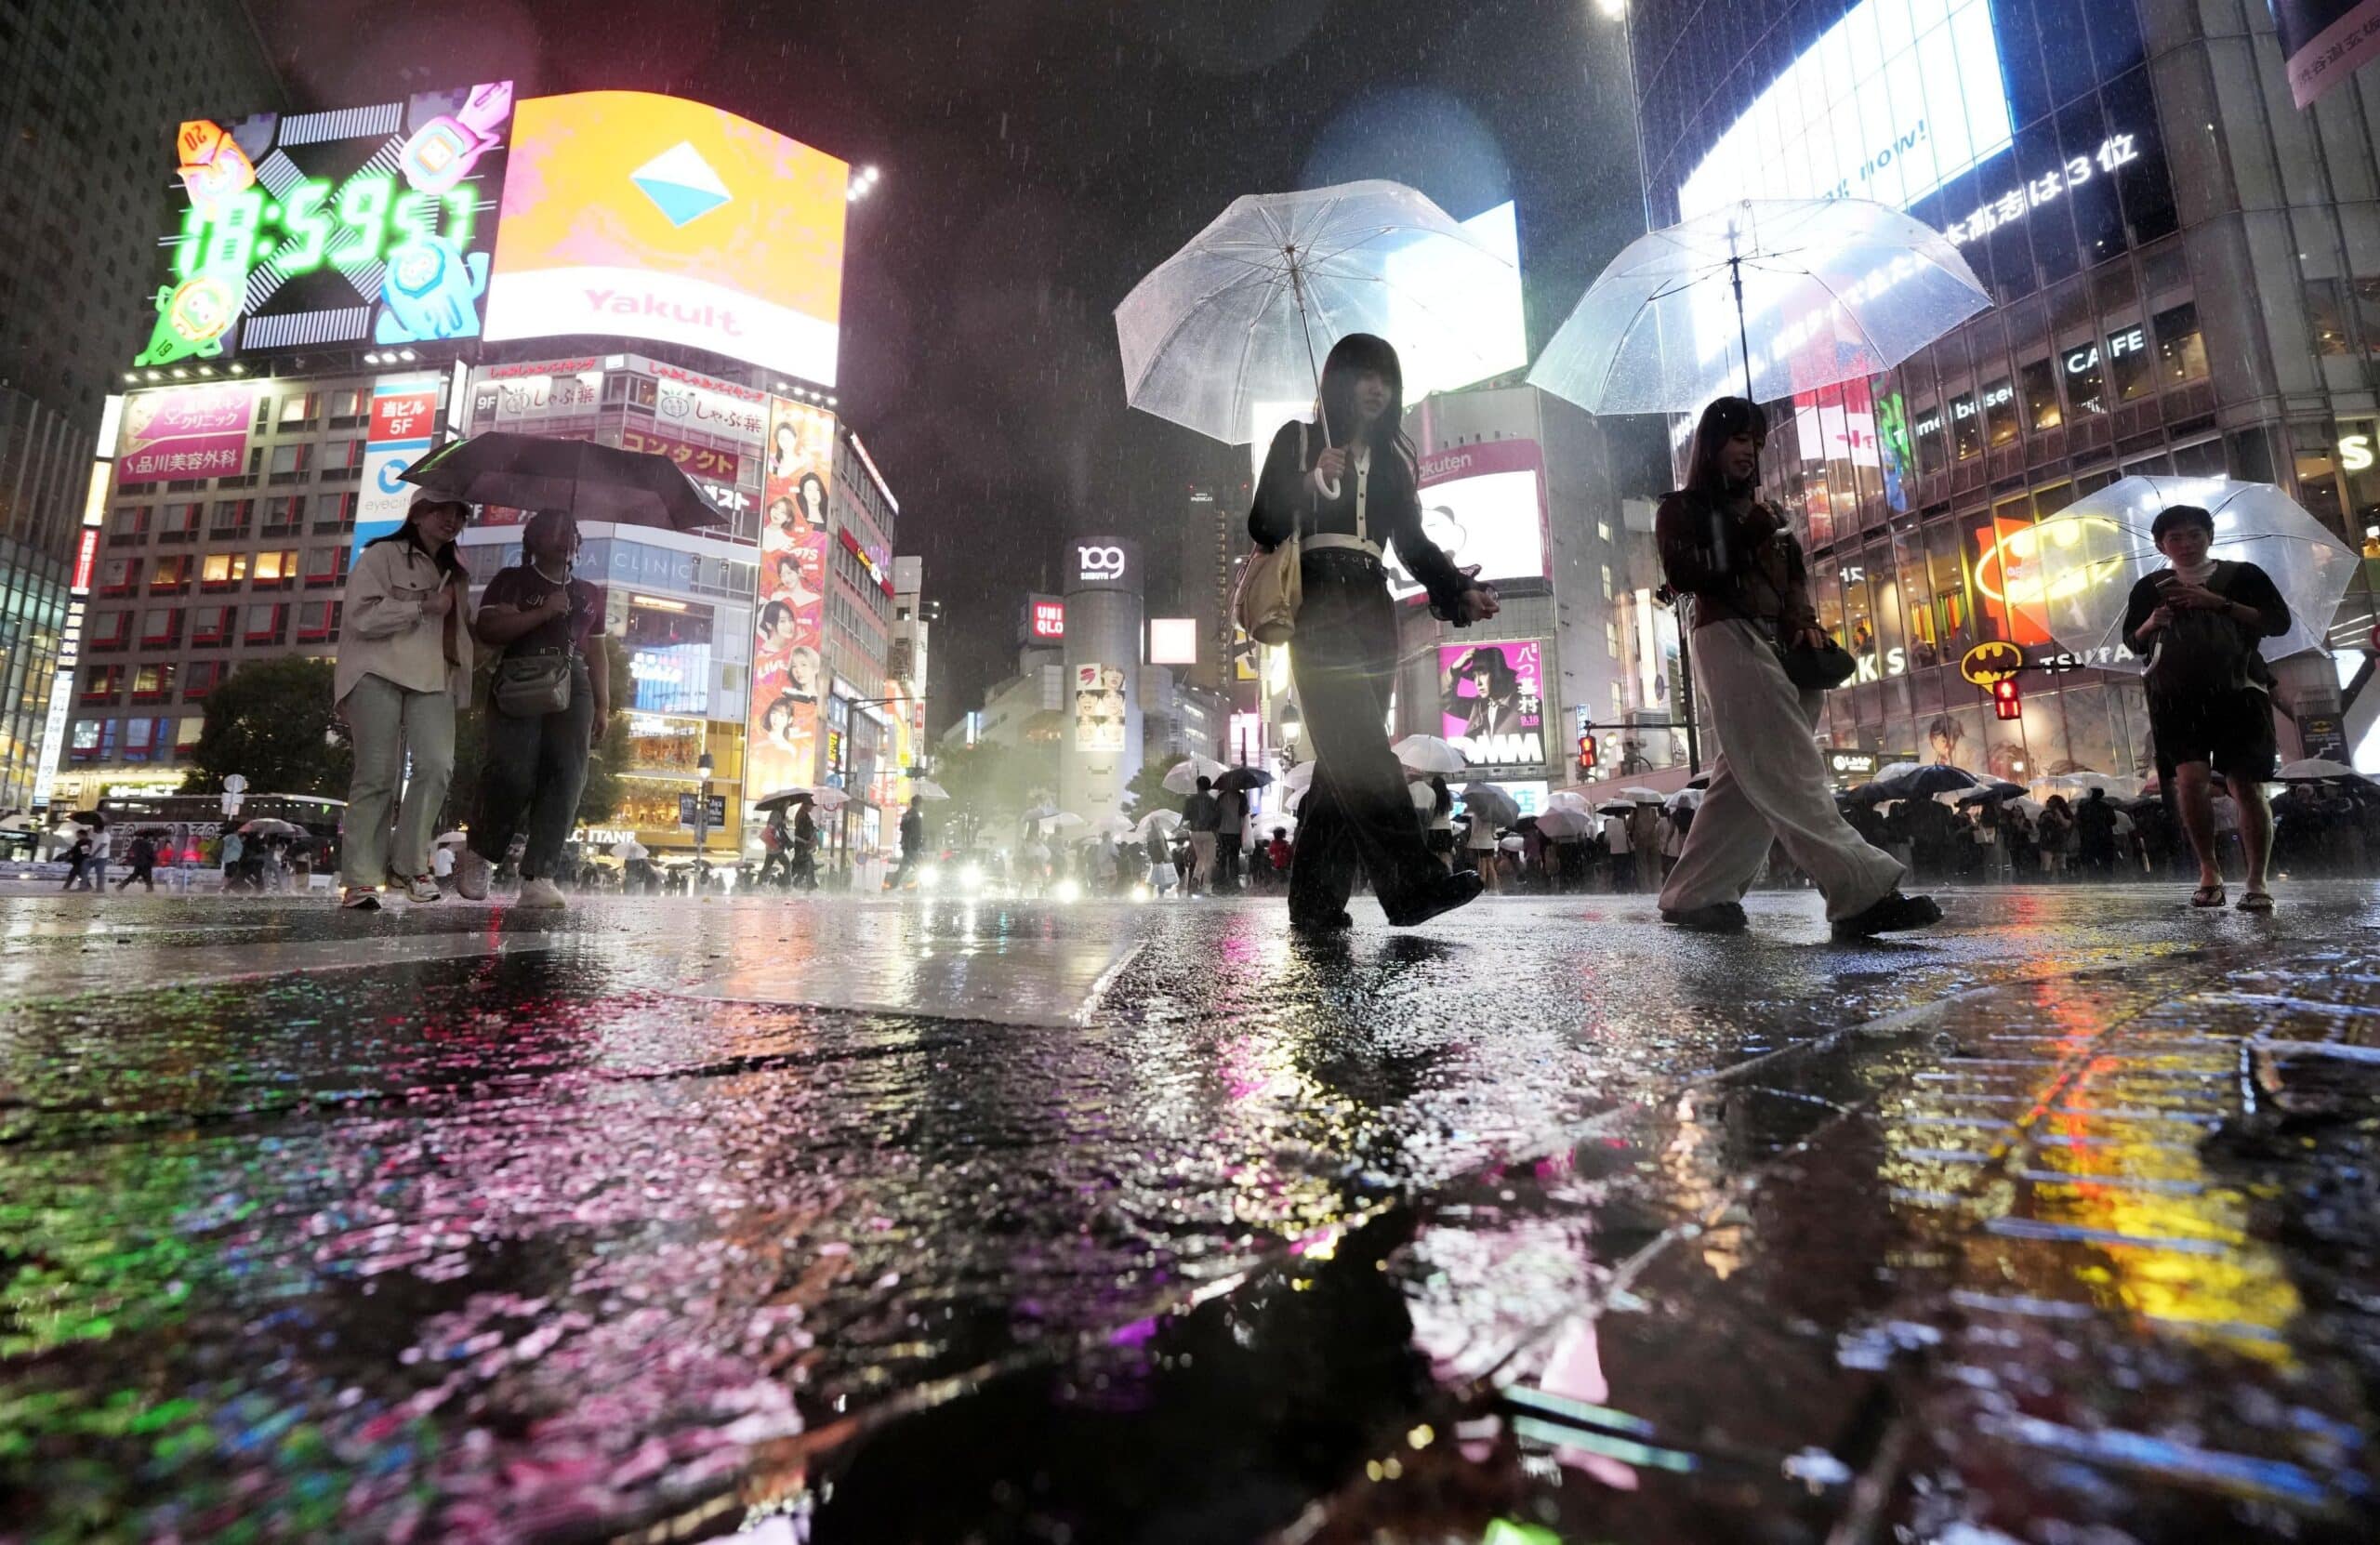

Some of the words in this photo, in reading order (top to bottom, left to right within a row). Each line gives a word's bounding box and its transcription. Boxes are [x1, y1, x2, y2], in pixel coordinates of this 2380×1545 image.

[1860, 119, 1925, 181] now!
[582, 289, 742, 337] Yakult
[2068, 330, 2144, 373] CAFE
[381, 400, 425, 417] 当ビル
[477, 396, 496, 410] 9F
[695, 401, 762, 433] しゃぶ葉
[390, 417, 414, 435] 5F
[1893, 415, 1941, 445] Tme
[136, 450, 237, 474] 品川美容外科
[624, 432, 735, 474] コンタクト
[1410, 453, 1472, 478] akuten
[364, 497, 410, 514] eyecit
[615, 553, 690, 579] CLINIC
[1078, 546, 1125, 579] 109
[1037, 605, 1063, 620] UNI
[1037, 620, 1064, 635] QLO
[1516, 646, 1540, 714] 八つ墓村
[1840, 647, 1905, 686] KS
